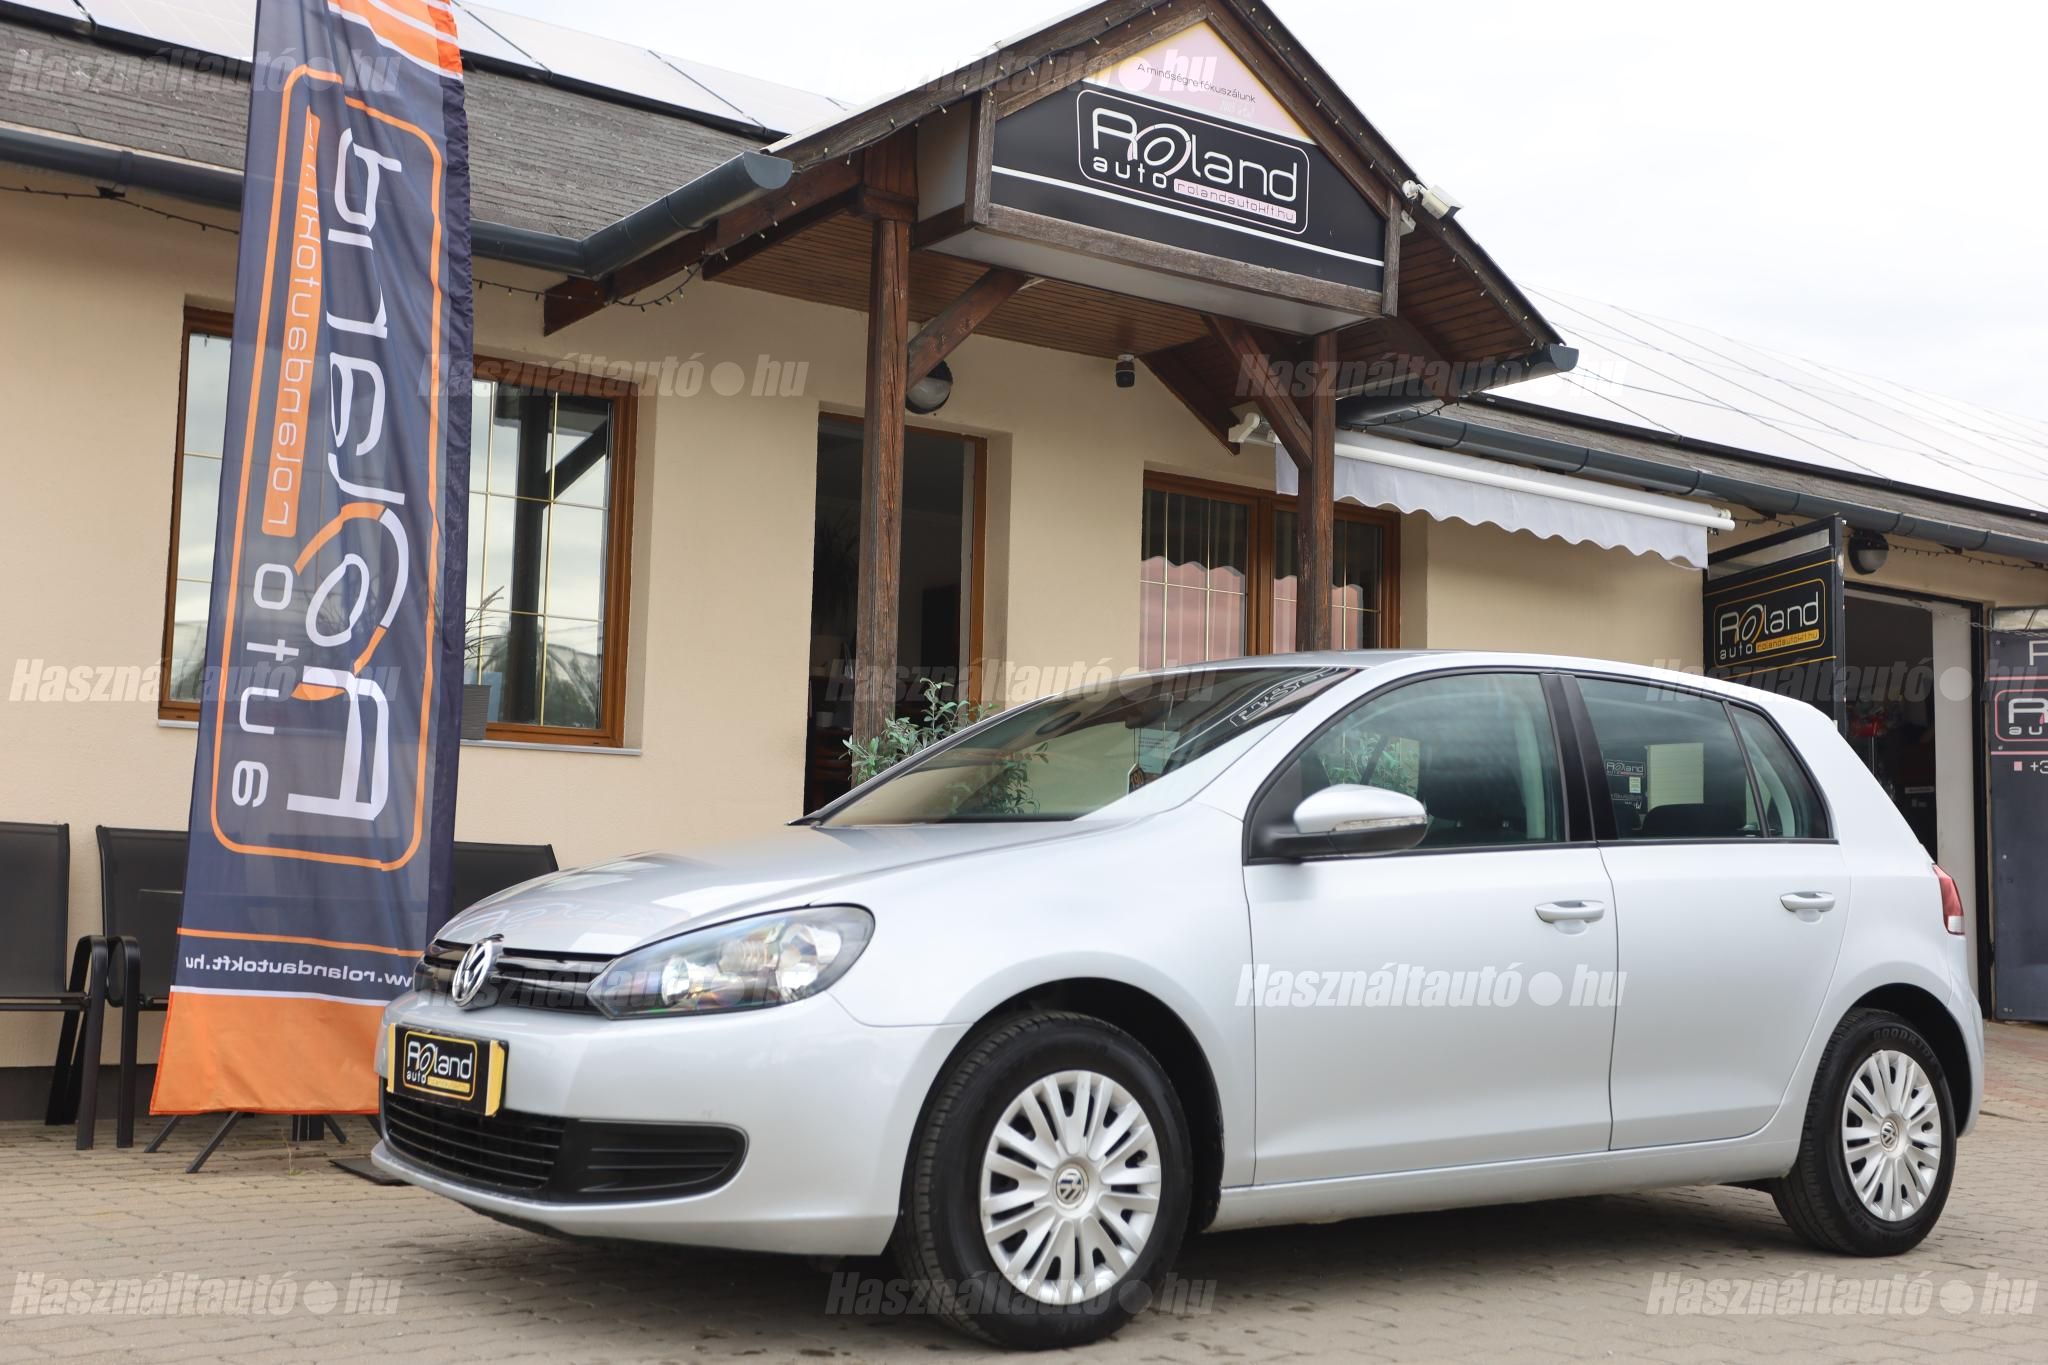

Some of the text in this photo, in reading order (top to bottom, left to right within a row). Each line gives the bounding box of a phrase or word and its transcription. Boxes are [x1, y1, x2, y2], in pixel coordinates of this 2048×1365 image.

[1137, 63, 1256, 103] A minőségre fókuszálunk
[1092, 108, 1297, 202] Roland
[1093, 156, 1167, 189] auto
[1176, 182, 1295, 221] rolandautokft.hu
[1720, 591, 1819, 646] Roland
[1720, 641, 1753, 660] auto
[406, 1070, 427, 1084] auto
[407, 1041, 473, 1079] Roland
